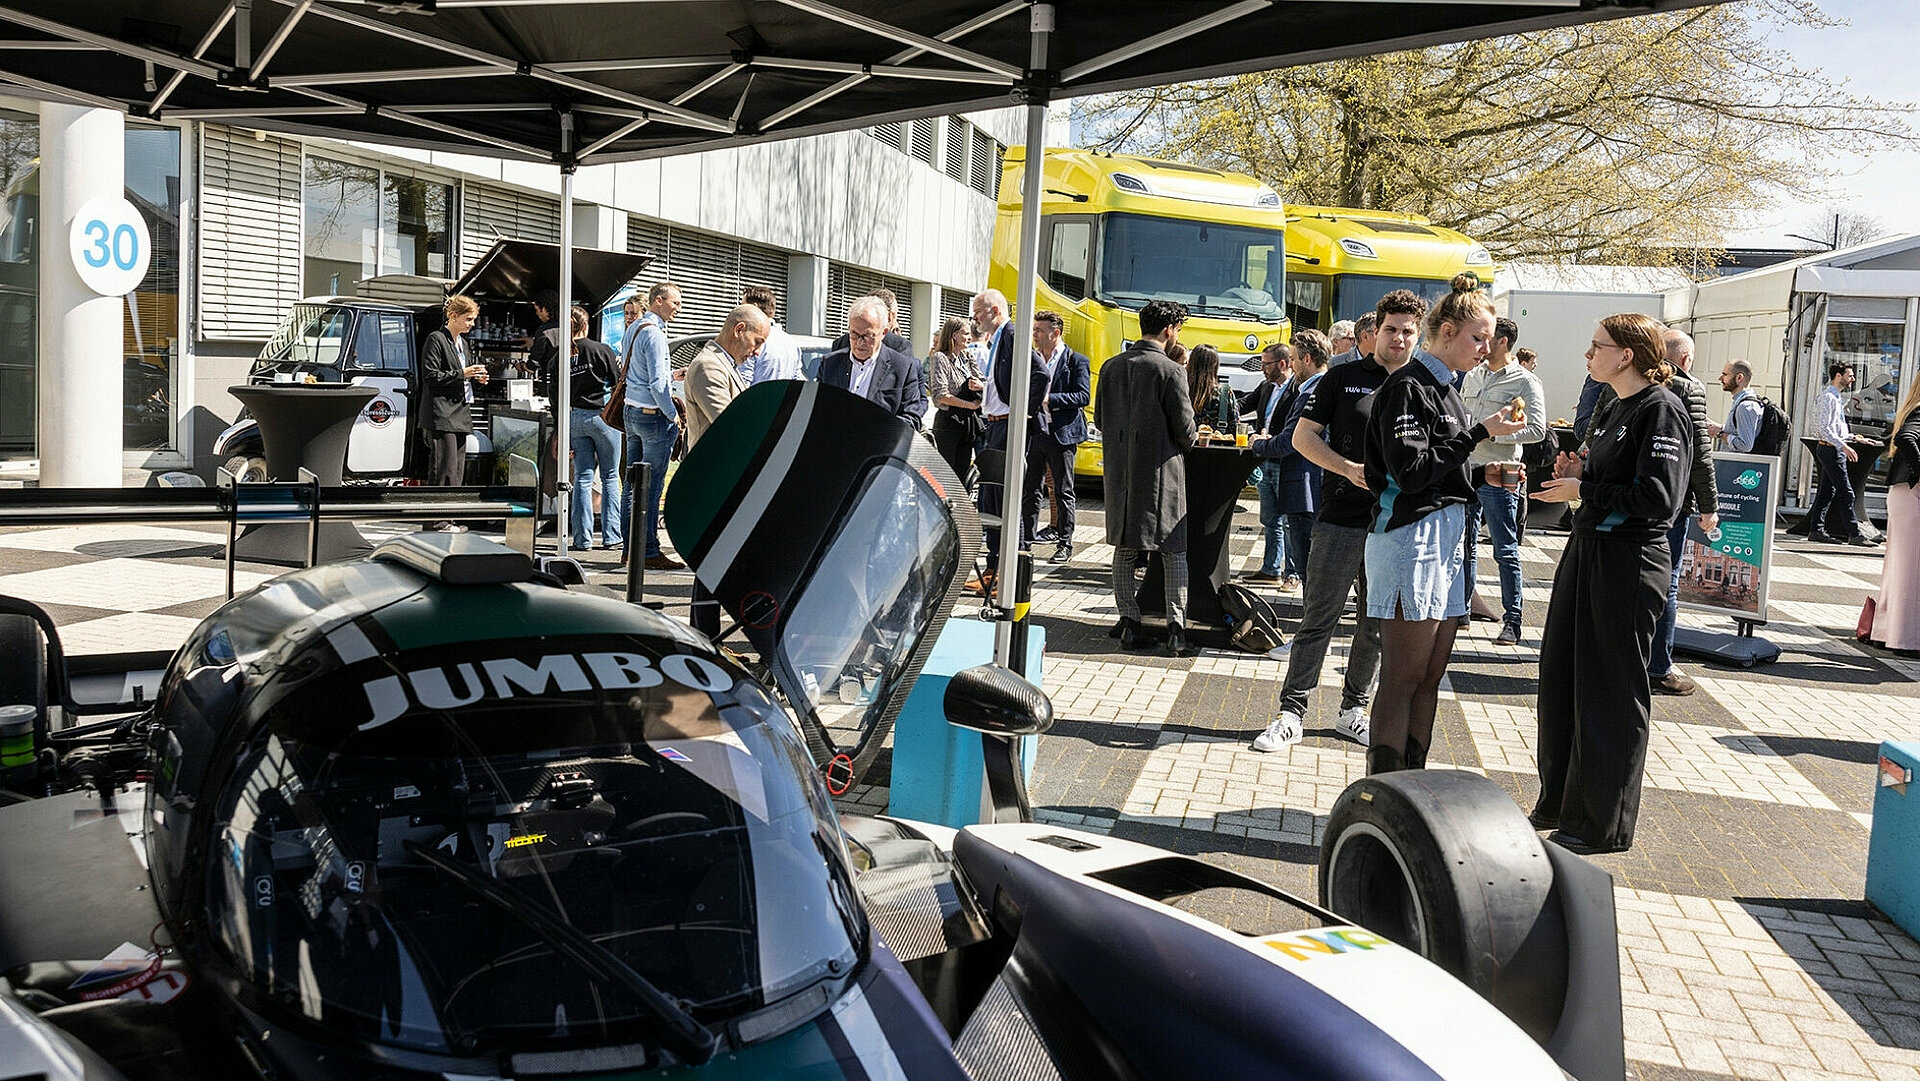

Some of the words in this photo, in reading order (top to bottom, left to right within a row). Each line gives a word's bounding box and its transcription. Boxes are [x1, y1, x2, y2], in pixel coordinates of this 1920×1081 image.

[83, 219, 139, 271] 30
[1521, 308, 1528, 317] 8
[358, 652, 734, 731] JUMBO
[1263, 929, 1392, 961] NXP
